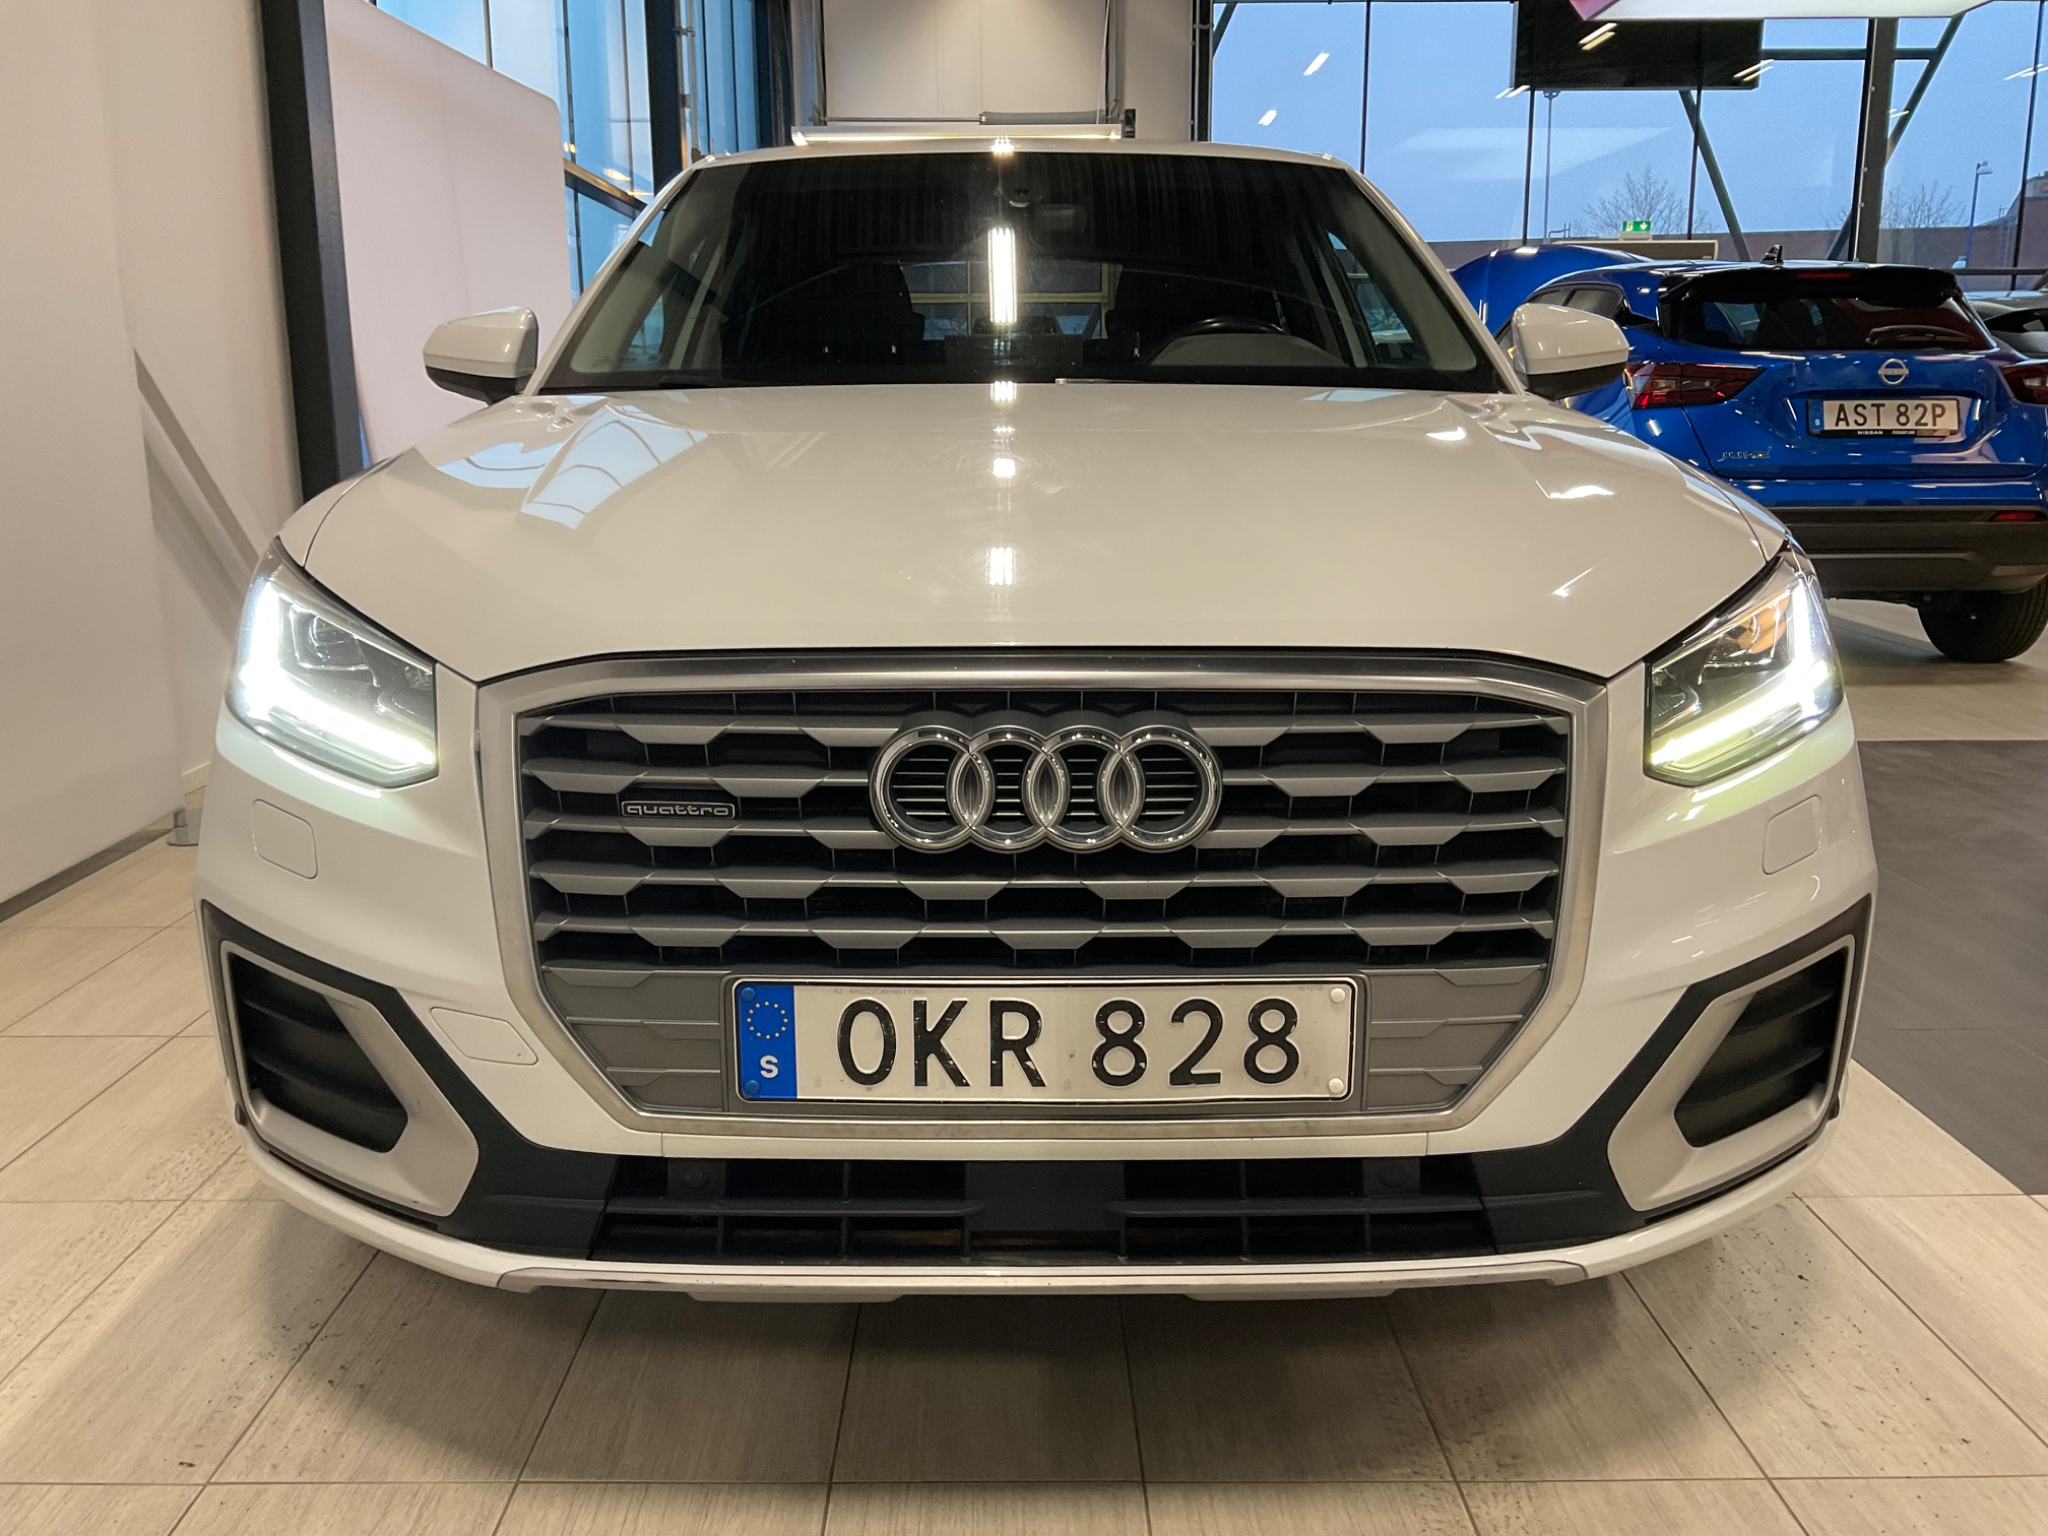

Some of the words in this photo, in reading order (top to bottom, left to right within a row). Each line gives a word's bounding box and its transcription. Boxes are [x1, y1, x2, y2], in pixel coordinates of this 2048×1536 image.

[1814, 418, 1821, 427] S
[1834, 403, 1886, 427] AST
[1896, 403, 1946, 427] 82P
[627, 804, 729, 816] quattro
[836, 998, 1046, 1087] OKR
[1091, 998, 1300, 1087] 828
[760, 1055, 779, 1079] S
